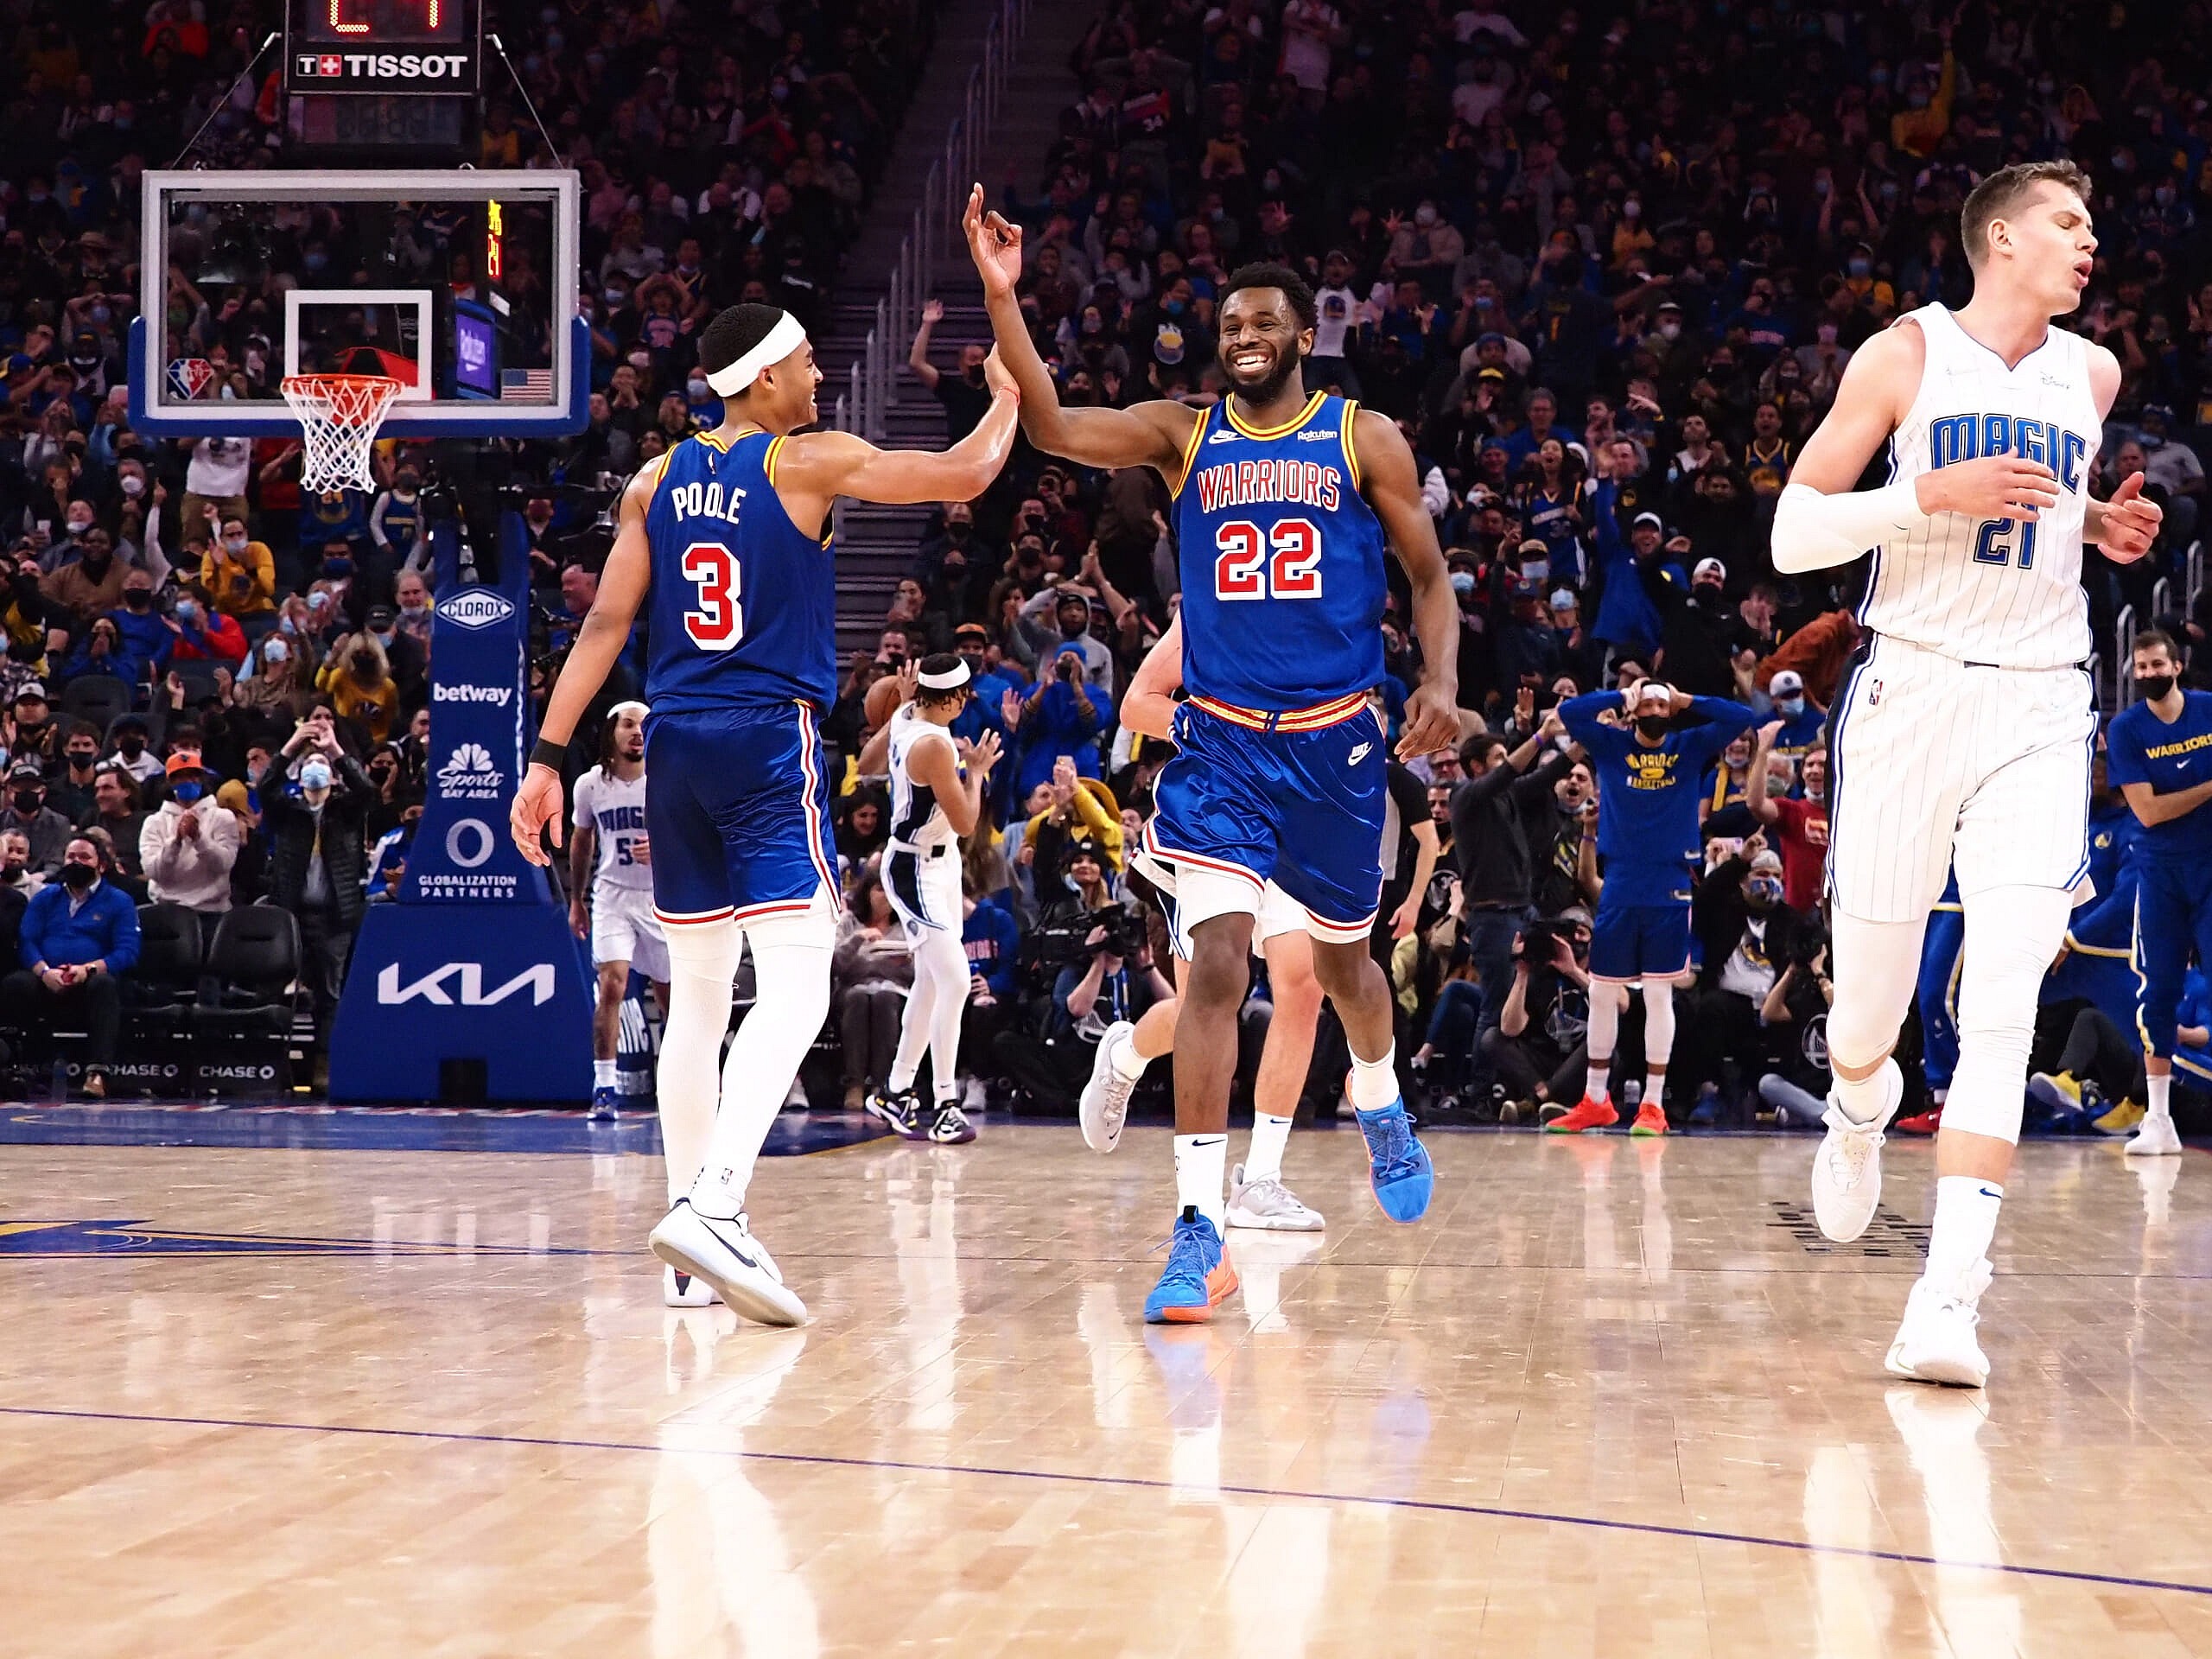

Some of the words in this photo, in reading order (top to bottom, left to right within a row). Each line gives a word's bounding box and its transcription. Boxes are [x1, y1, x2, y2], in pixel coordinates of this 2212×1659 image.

[344, 54, 468, 78] TISSOT
[1297, 429, 1338, 442] Rakuten
[1930, 413, 2086, 495] MAGIC
[1197, 460, 1342, 514] WARRIORS
[671, 481, 747, 524] POOLE
[1215, 518, 1323, 601] 22
[681, 542, 744, 651] 3
[448, 601, 505, 617] CLOROX
[433, 683, 512, 707] betway
[436, 767, 505, 789] Sports
[441, 789, 464, 798] BAY
[466, 790, 499, 799] AREA
[598, 806, 645, 831] MAG
[418, 875, 518, 887] GLOBALIZATION
[420, 887, 515, 899] PARTNERS
[200, 1065, 257, 1078] CHASE
